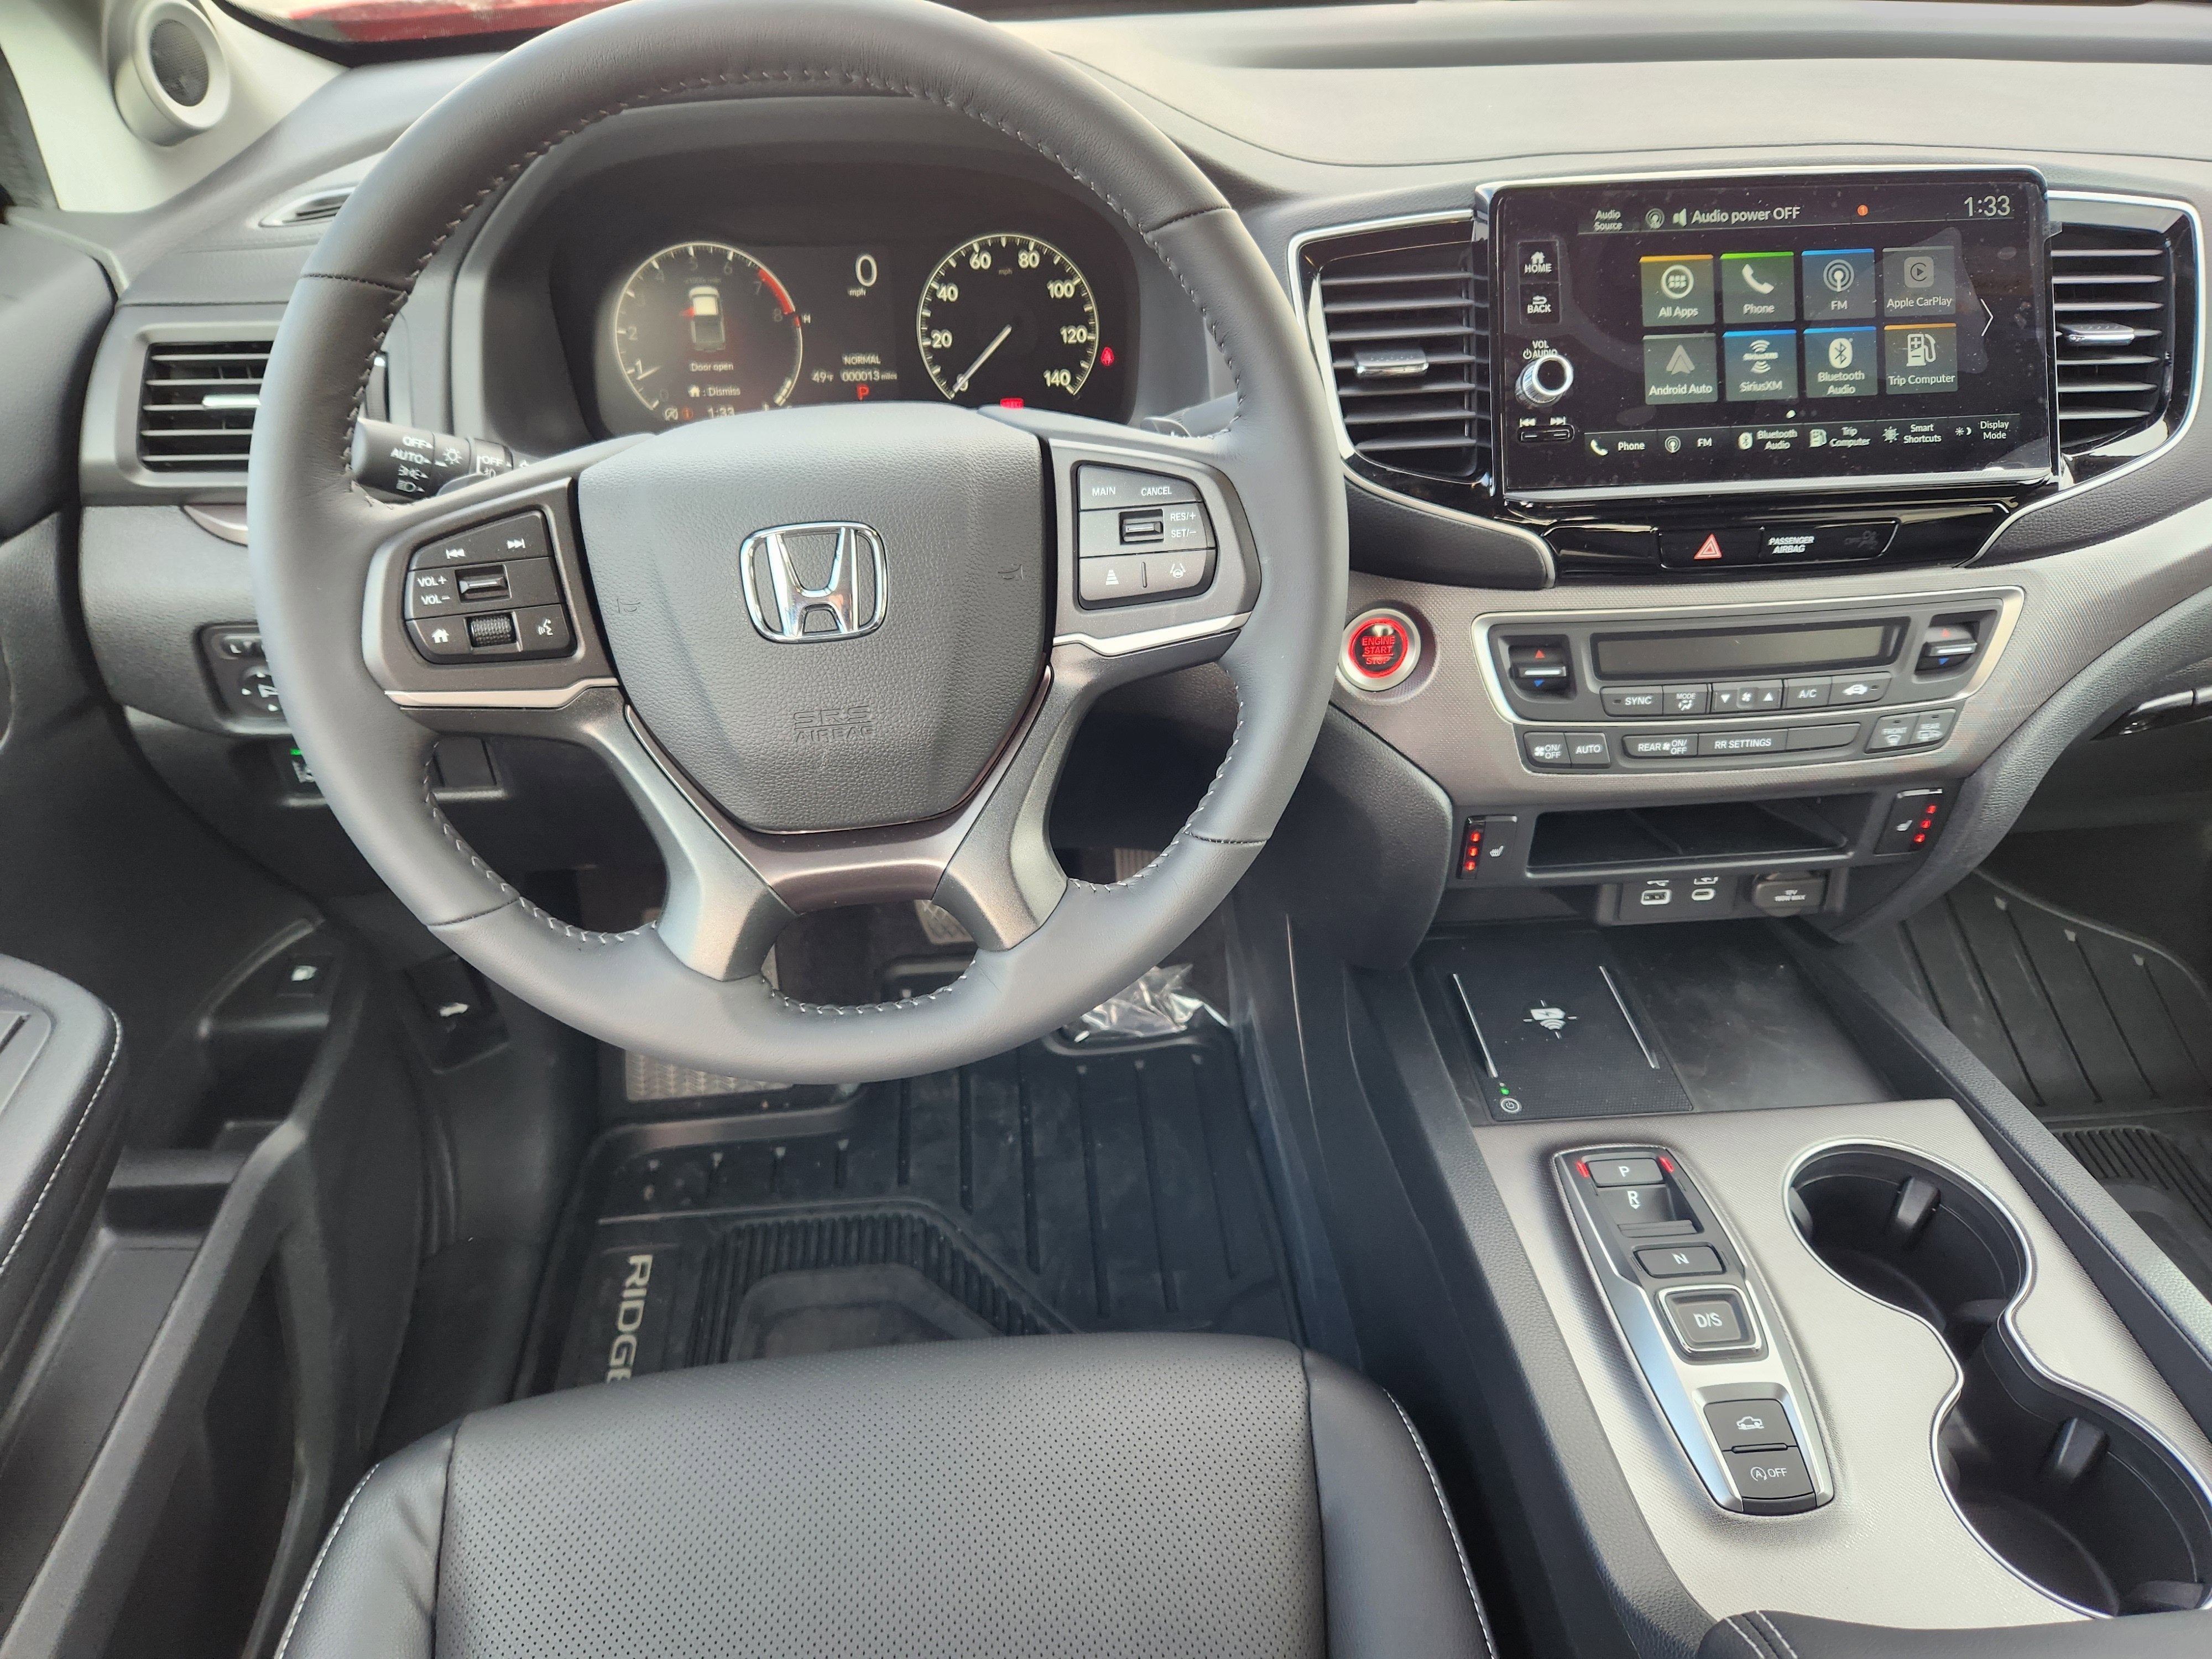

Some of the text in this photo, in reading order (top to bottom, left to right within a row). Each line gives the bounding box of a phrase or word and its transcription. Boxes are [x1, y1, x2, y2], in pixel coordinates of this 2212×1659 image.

[1963, 195, 2011, 217] 1:33
[1595, 210, 1621, 220] Audio
[1691, 207, 1801, 224] Audio power OFF
[1594, 222, 1623, 231] Source
[970, 251, 992, 270] 60
[1019, 250, 1040, 269] 80
[855, 254, 878, 287] 0
[999, 267, 1013, 275] mph
[1524, 263, 1552, 274] HOME
[848, 288, 866, 297] mph
[937, 283, 958, 301] 40
[1047, 280, 1074, 299] 100
[1831, 300, 1848, 310] FM
[1887, 296, 1953, 309] Apple CarPlay
[1527, 304, 1551, 314] BACK
[1659, 306, 1699, 319] All Apps
[1743, 303, 1775, 315] Phone
[628, 327, 638, 341] 2
[931, 330, 952, 348] 20
[1060, 325, 1087, 344] 120
[1532, 340, 1550, 349] VOL
[1532, 349, 1557, 358] AUDIO
[843, 354, 881, 365] NORMAL
[635, 359, 643, 374] 1
[690, 362, 734, 373] Door open
[842, 371, 880, 382] 000013
[1044, 369, 1071, 387] 140
[1818, 371, 1865, 382] Bluetooth
[1888, 374, 1955, 385] Trip Computer
[1649, 384, 1713, 395] Android Auto
[1739, 380, 1783, 392] SiriusXM
[1827, 384, 1855, 395] Audio
[708, 387, 741, 397] Dismiss
[858, 384, 869, 401] P
[1911, 424, 1934, 433] Smart
[1980, 421, 2010, 431] Display
[1756, 430, 1797, 440] Bluetooth
[1841, 427, 1858, 437] Trip
[1983, 430, 2006, 440] Mode
[1697, 438, 1712, 447] FM
[1829, 437, 1870, 448] Computer
[1903, 434, 1942, 444] Shortcuts
[1618, 441, 1645, 451] Phone
[1765, 440, 1790, 450] Audio
[390, 448, 424, 464] AUTO
[482, 456, 504, 466] OFF
[1092, 487, 1116, 496] MAIN
[1141, 487, 1172, 496] CANCEL
[1768, 536, 1814, 545] PASSENGER
[1772, 545, 1806, 554] AIRBAG
[1362, 637, 1395, 646] ENGINE
[1364, 646, 1392, 654] START
[1798, 689, 1817, 699] A/C
[1625, 696, 1652, 706] SYNC
[1637, 743, 1661, 753] REAR
[1714, 738, 1772, 749] RR SETTINGS
[1545, 751, 1561, 759] OFF
[1575, 744, 1601, 755] AUTO
[1671, 747, 1687, 755] OFF
[1619, 1166, 1630, 1177] P
[1627, 1191, 1640, 1204] R
[1672, 1253, 1689, 1264] N
[1693, 1312, 1723, 1327] D/S
[1767, 1468, 1787, 1478] OFF
